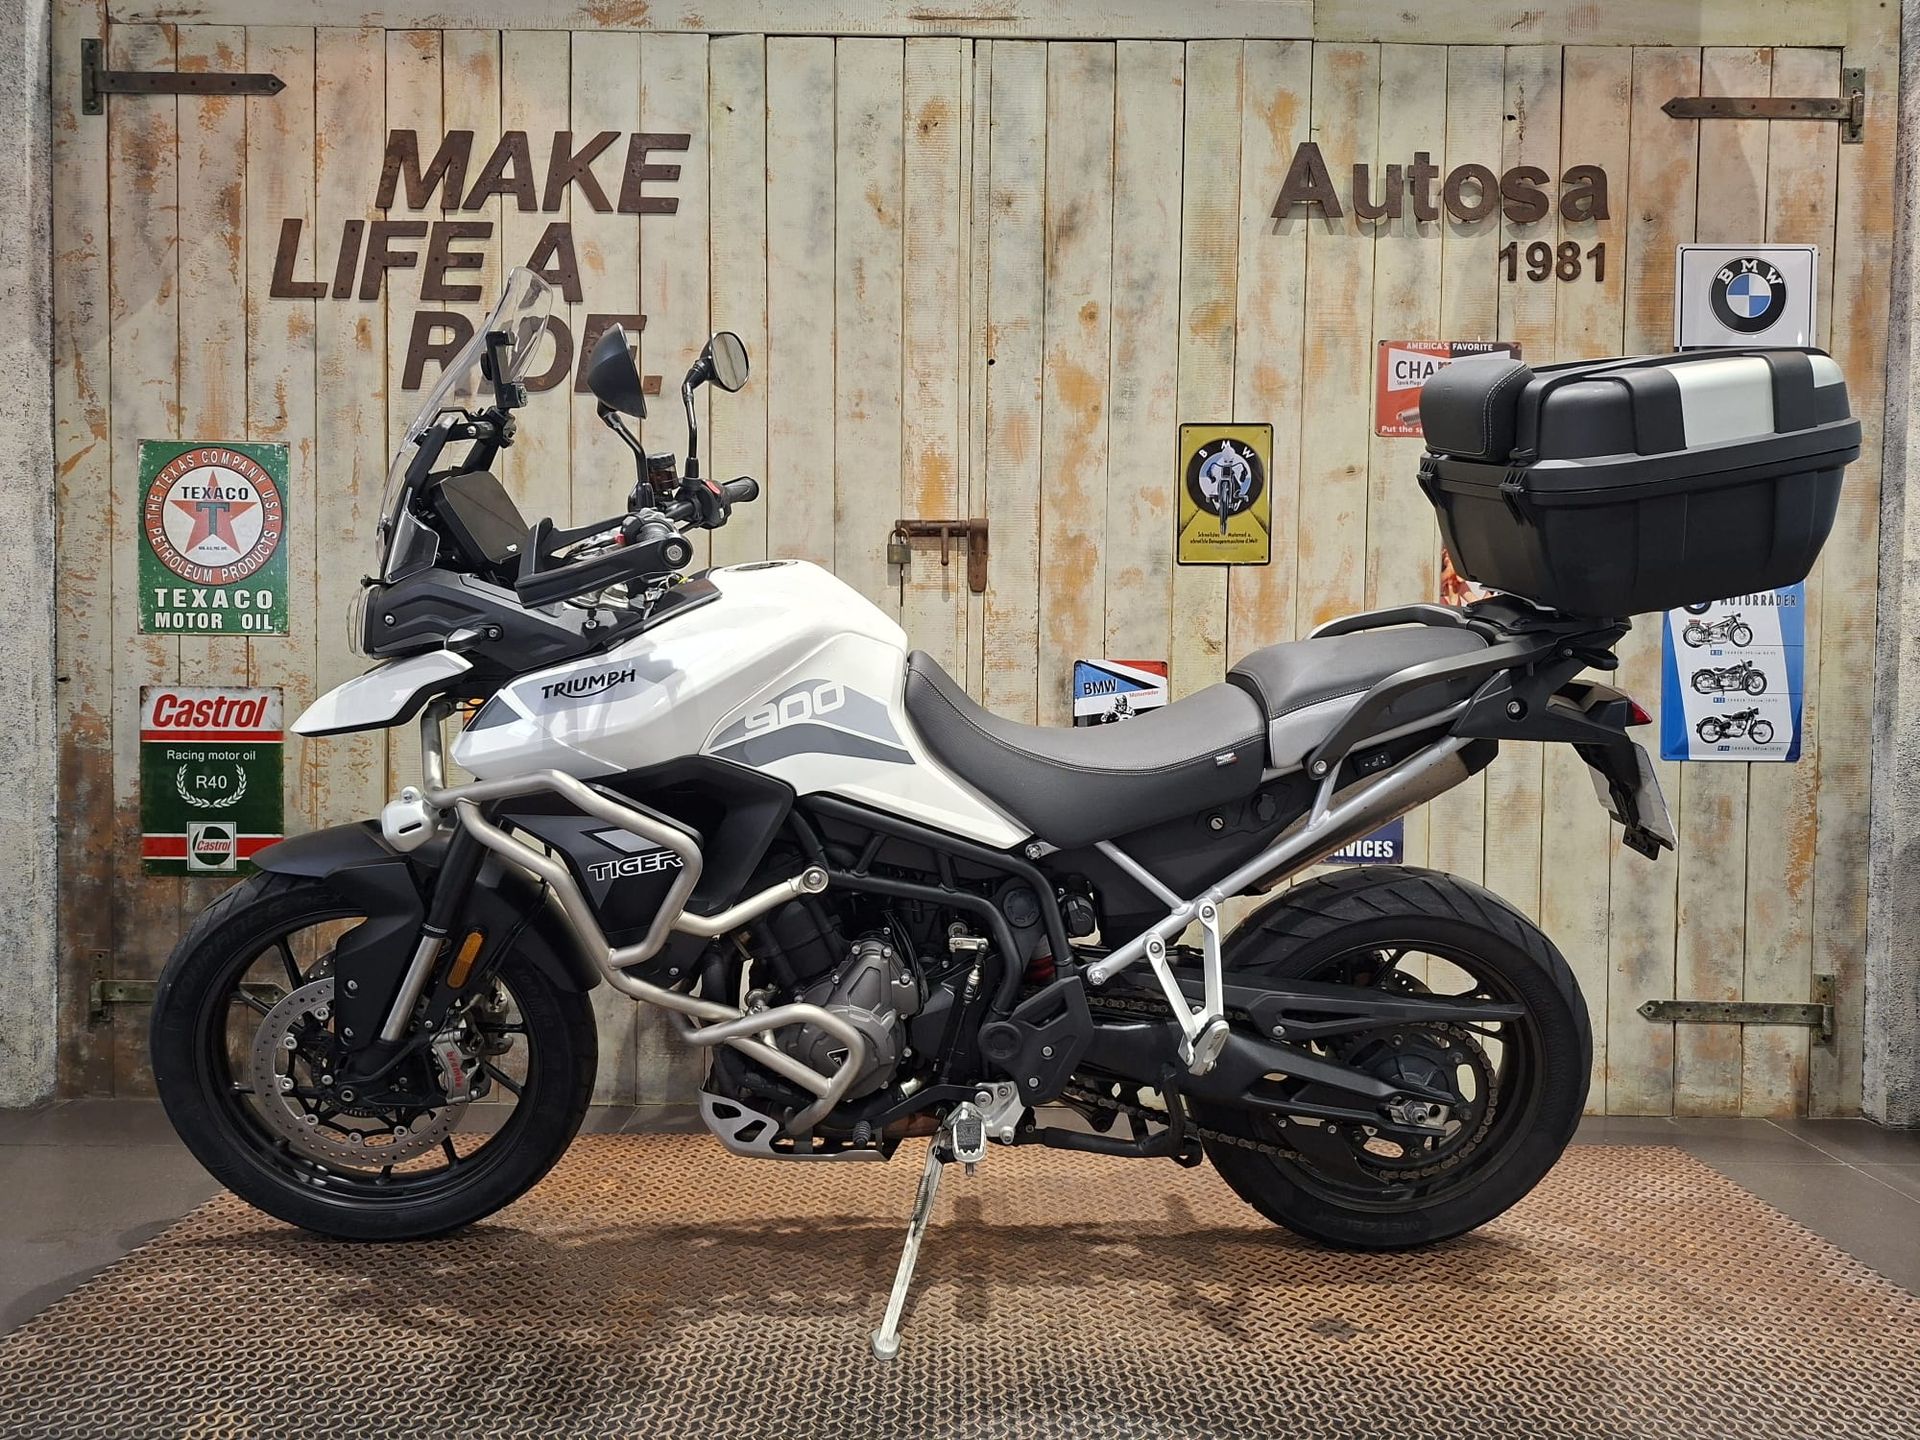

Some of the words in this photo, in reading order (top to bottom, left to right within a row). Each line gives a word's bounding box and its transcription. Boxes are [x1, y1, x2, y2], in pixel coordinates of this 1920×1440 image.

[375, 129, 691, 213] MAKE
[1270, 142, 1611, 223] Autosa
[270, 218, 494, 300] LIFE
[518, 222, 583, 302] A
[1500, 241, 1606, 282] 1981
[1717, 259, 1783, 285] BMW
[1406, 342, 1450, 350] AMERICA'S
[1452, 342, 1493, 351] FAVORITE
[1381, 425, 1397, 433] Put
[1398, 425, 1413, 433] the
[1198, 440, 1255, 458] BMW
[147, 494, 162, 520] THE
[155, 454, 195, 490] TEXAS
[201, 450, 267, 485] COMPANY
[181, 486, 249, 500] TEXACO
[196, 502, 230, 535] T
[149, 527, 213, 582] PETROLEUM
[221, 530, 277, 582] PRODUCTS
[154, 588, 273, 609] TEXACO
[154, 612, 223, 629] MOTOR
[241, 613, 273, 630] OIL
[541, 669, 636, 699] TRIUMPH
[1084, 679, 1116, 694] BMW
[153, 694, 268, 727] Castrol
[744, 682, 846, 736] 900
[166, 750, 205, 763] Racing
[208, 751, 240, 761] motor
[243, 750, 256, 761] oil
[196, 775, 228, 789] R40
[196, 839, 231, 852] Castrol
[1331, 840, 1394, 858] VICES
[588, 850, 684, 881] TIGER
